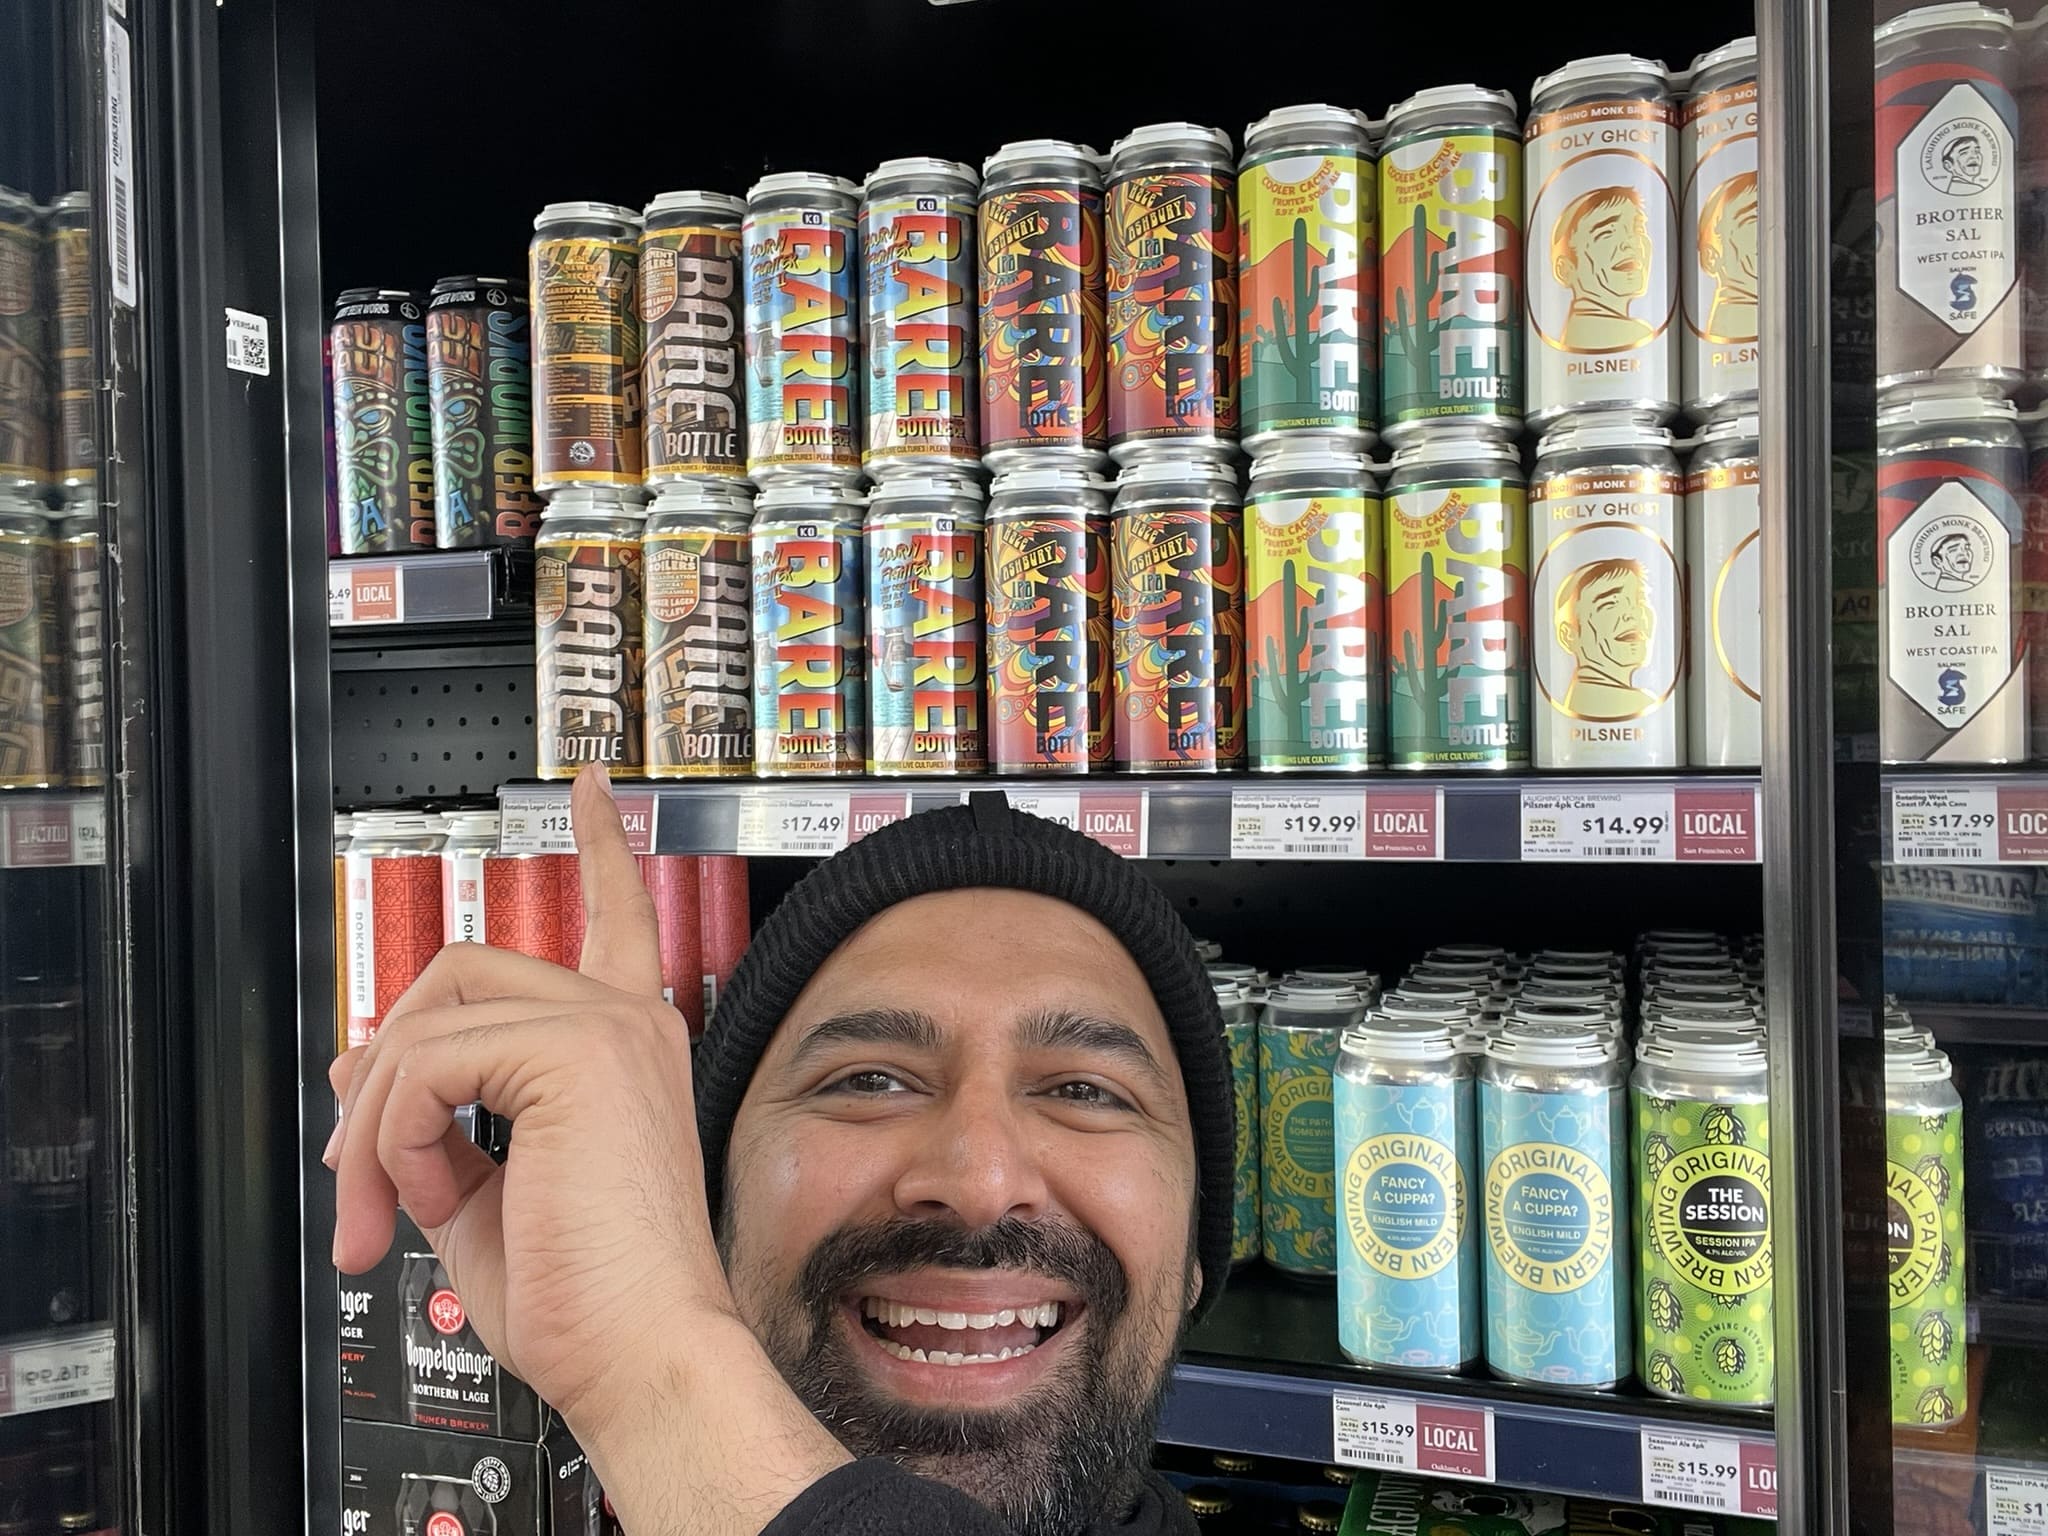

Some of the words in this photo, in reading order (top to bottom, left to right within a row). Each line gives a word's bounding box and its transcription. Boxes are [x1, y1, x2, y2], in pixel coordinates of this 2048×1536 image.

[1590, 105, 1624, 117] MONK
[1952, 121, 1980, 131] MONK
[1387, 165, 1416, 183] COOLER
[1419, 141, 1456, 178] CACTUS
[1261, 175, 1296, 196] COOLER
[1299, 159, 1334, 193] CACTUS
[918, 200, 935, 211] KO
[804, 213, 821, 224] KO
[1126, 195, 1186, 246] ASHBURY
[1915, 207, 2004, 226] BROTHER
[987, 211, 1039, 260] ASHBURY
[1945, 228, 1981, 242] SAL
[1438, 151, 1512, 376] BARE
[1917, 252, 1948, 265] WEST
[1951, 250, 1988, 262] COAST
[1990, 250, 2005, 260] IPA
[1318, 171, 1370, 389] BARE
[1163, 185, 1229, 397] BARE
[1017, 202, 1086, 409] BARE
[893, 215, 964, 418] BARE
[1949, 311, 1977, 321] SAFE
[778, 227, 849, 427] BARE
[665, 257, 737, 430] BARE
[1566, 358, 1641, 376] PILSNER
[1712, 348, 1758, 368] PILSN
[783, 426, 838, 446] BOTTLE
[897, 417, 951, 438] BOTTLE
[666, 431, 737, 458] BOTTLE
[1593, 480, 1626, 490] MONK
[1255, 516, 1285, 537] COOLER
[1287, 501, 1323, 536] CACTUS
[1392, 508, 1422, 529] COOLER
[1426, 491, 1461, 527] CACTUS
[800, 527, 816, 537] KO
[938, 520, 954, 530] KO
[1914, 523, 1940, 565] LAUGHING
[1941, 519, 1971, 529] MONK
[1000, 541, 1057, 583] ASHBURY
[1129, 532, 1188, 580] ASHBURY
[356, 585, 393, 603] LOCAL
[1307, 511, 1368, 726] BARE
[1446, 501, 1518, 723] BARE
[1904, 602, 1997, 619] BROTHER
[912, 535, 978, 733] BARE
[1033, 531, 1099, 733] BARE
[1164, 523, 1232, 728] BARE
[1933, 623, 1971, 637] SAL
[684, 560, 751, 730] BARE
[776, 540, 844, 734] BARE
[554, 567, 623, 733] BARE
[1906, 646, 1936, 657] WEST
[1939, 646, 1978, 656] COAST
[1981, 645, 1998, 655] IPA
[1937, 661, 1966, 669] SALMON
[1937, 705, 1967, 715] SAFE
[779, 735, 835, 754] BOTTLE
[914, 733, 970, 753] BOTTLE
[1570, 728, 1643, 742] PILSNER
[555, 735, 623, 761] BOTTLE
[684, 732, 752, 759] BOTTLE
[1233, 802, 1260, 811] Rotating
[1523, 793, 1560, 802] LAUGHING
[1562, 793, 1586, 802] MONK
[1587, 793, 1622, 802] BREWING
[1523, 801, 1553, 809] Pilsner
[1554, 801, 1572, 810] 4pk
[1574, 801, 1596, 809] Cans
[541, 816, 573, 832] $13.
[781, 816, 840, 832] $17.49
[1085, 813, 1134, 833] LOCAL
[1284, 815, 1356, 833] $19.99
[1373, 812, 1429, 834] LOCAL
[1582, 816, 1664, 834] $14.99
[1684, 813, 1747, 836] LOCAL
[1929, 814, 1995, 828] $17.99
[1384, 844, 1415, 852] Francisco,
[1683, 847, 1697, 855] San
[1698, 847, 1732, 856] Francisco,
[1733, 847, 1745, 855] CA
[355, 911, 366, 1003] DOKKAEBIER
[1279, 1080, 1334, 1108] ORIGI
[1290, 1116, 1308, 1126] THE
[1270, 1110, 1317, 1193] BREWING
[1357, 1139, 1453, 1180] ORIGINAL
[1498, 1148, 1599, 1193] ORIGINAL
[1672, 1151, 1771, 1192] ORIGINAL
[1380, 1175, 1427, 1190] FANCY
[1372, 1191, 1382, 1203] A
[1384, 1192, 1436, 1206] CUPPA?
[1521, 1185, 1569, 1201] FANCY
[1708, 1187, 1744, 1204] THE
[1512, 1200, 1522, 1212] A
[1525, 1202, 1579, 1218] CUPPA?
[1685, 1204, 1764, 1224] SESSION
[1347, 1172, 1403, 1273] BREWING
[1372, 1214, 1413, 1227] ENGLISH
[1414, 1217, 1438, 1227] MILD
[1488, 1180, 1545, 1286] BREWING
[1512, 1226, 1554, 1239] ENGLISH
[1556, 1230, 1581, 1240] MILD
[1552, 1193, 1610, 1287] PATTERN
[1658, 1184, 1725, 1288] BREWING
[1695, 1236, 1741, 1248] SESSION
[1742, 1237, 1757, 1248] IPA
[1889, 1211, 1938, 1298] PATTER
[1699, 1322, 1739, 1341] BREWING
[412, 1383, 459, 1400] NORTHERN
[462, 1390, 490, 1404] LAGER
[414, 1412, 447, 1426] TRUMER
[450, 1418, 490, 1430] BREWERY
[1361, 1421, 1415, 1438] $15.99
[1424, 1425, 1478, 1452] LOCAL
[1678, 1461, 1737, 1479] $15.99
